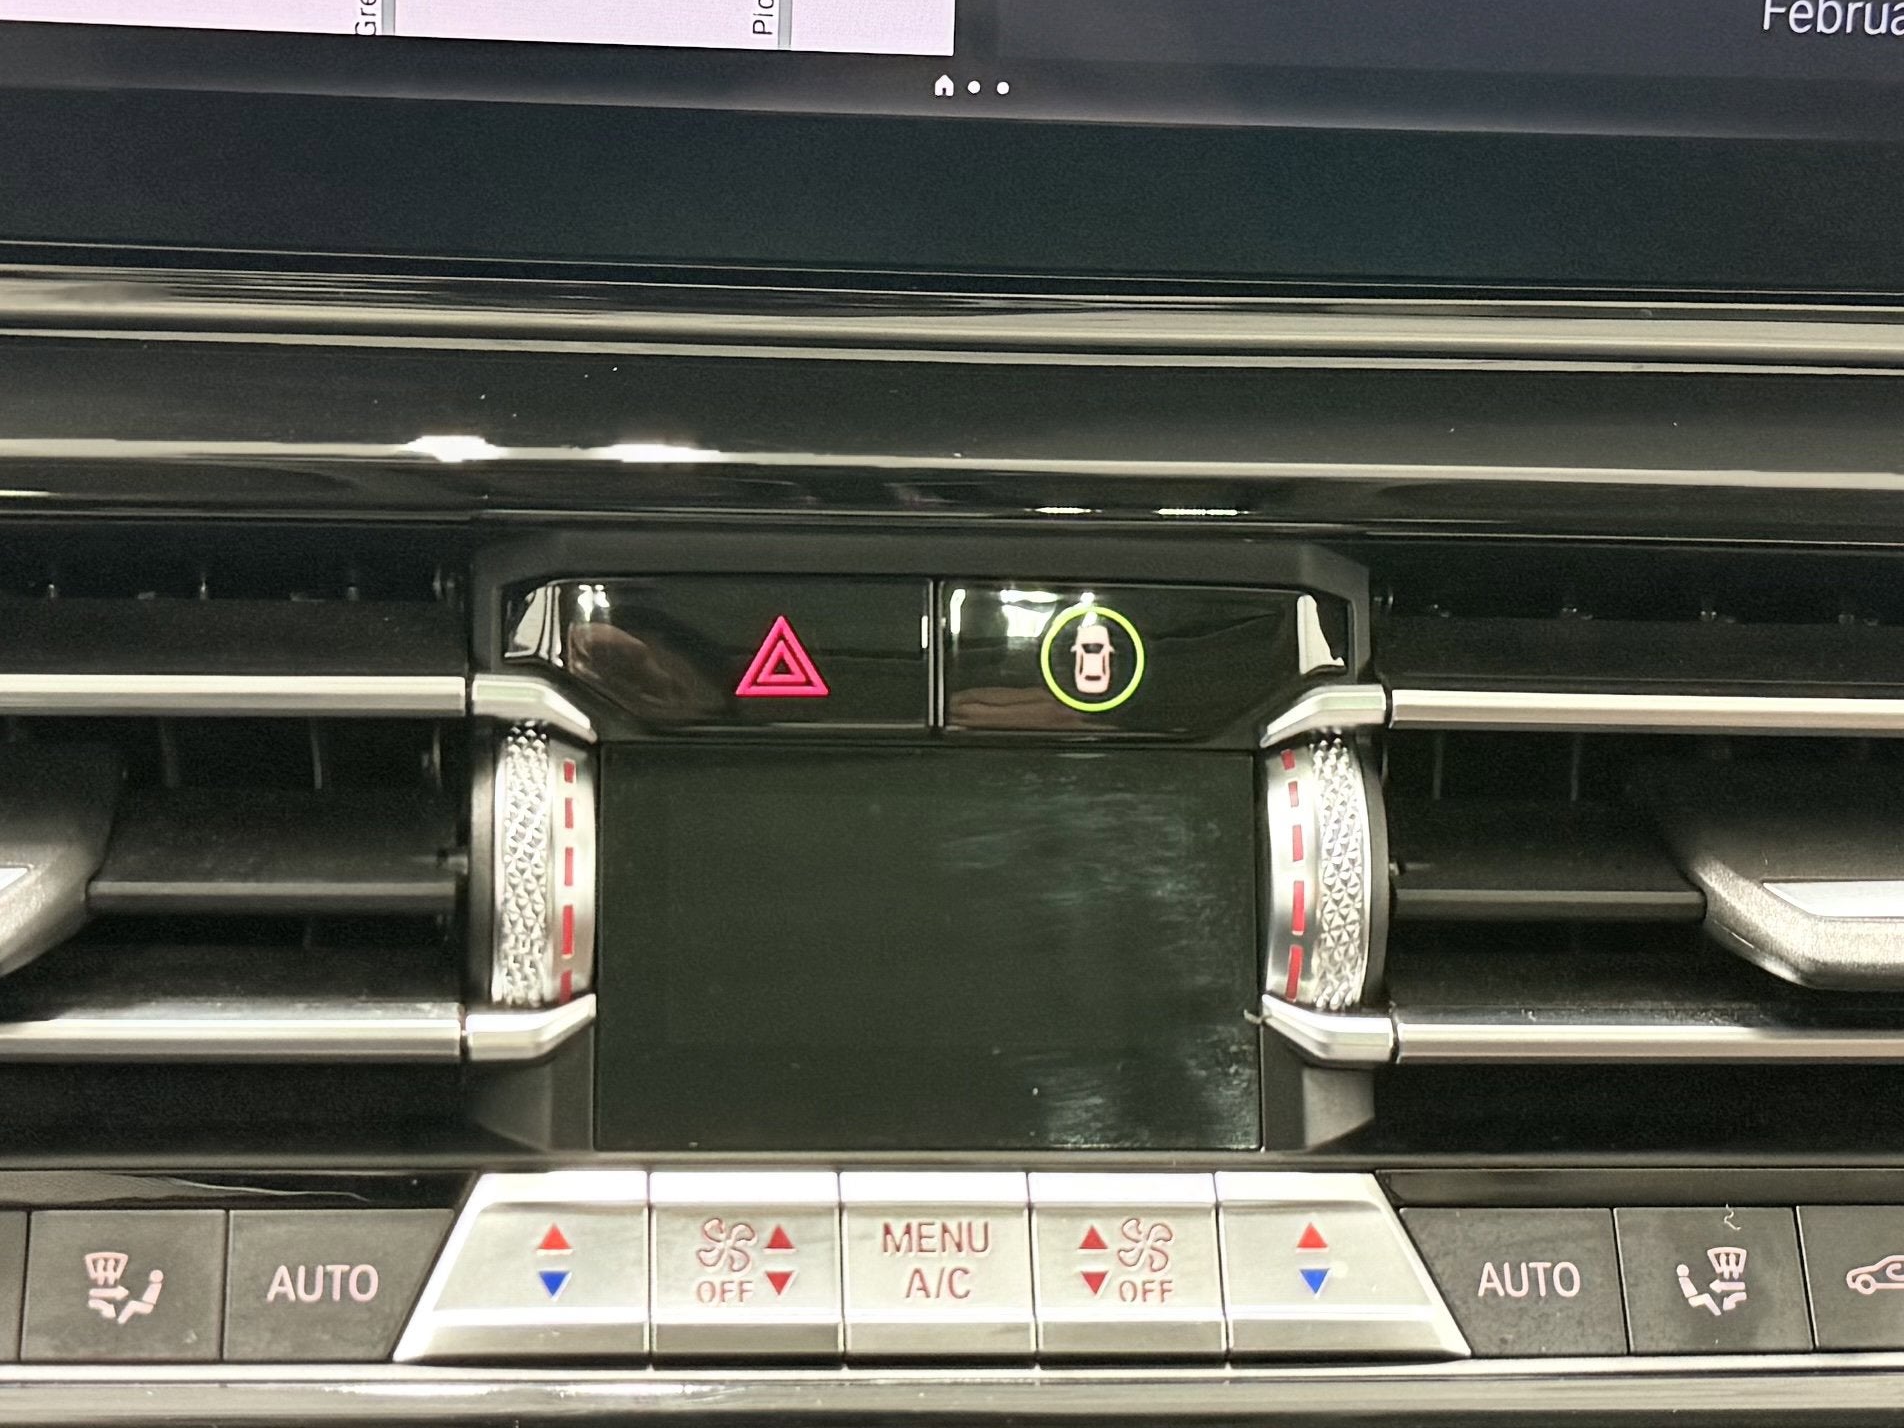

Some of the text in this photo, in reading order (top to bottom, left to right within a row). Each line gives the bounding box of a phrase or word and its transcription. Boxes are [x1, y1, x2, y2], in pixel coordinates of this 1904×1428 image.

[882, 1220, 991, 1256] MENU
[267, 1264, 379, 1304] AUTO
[696, 1278, 753, 1304] OFF
[904, 1265, 972, 1302] A/C
[1118, 1277, 1175, 1304] OFF
[1477, 1261, 1582, 1300] AUTO
